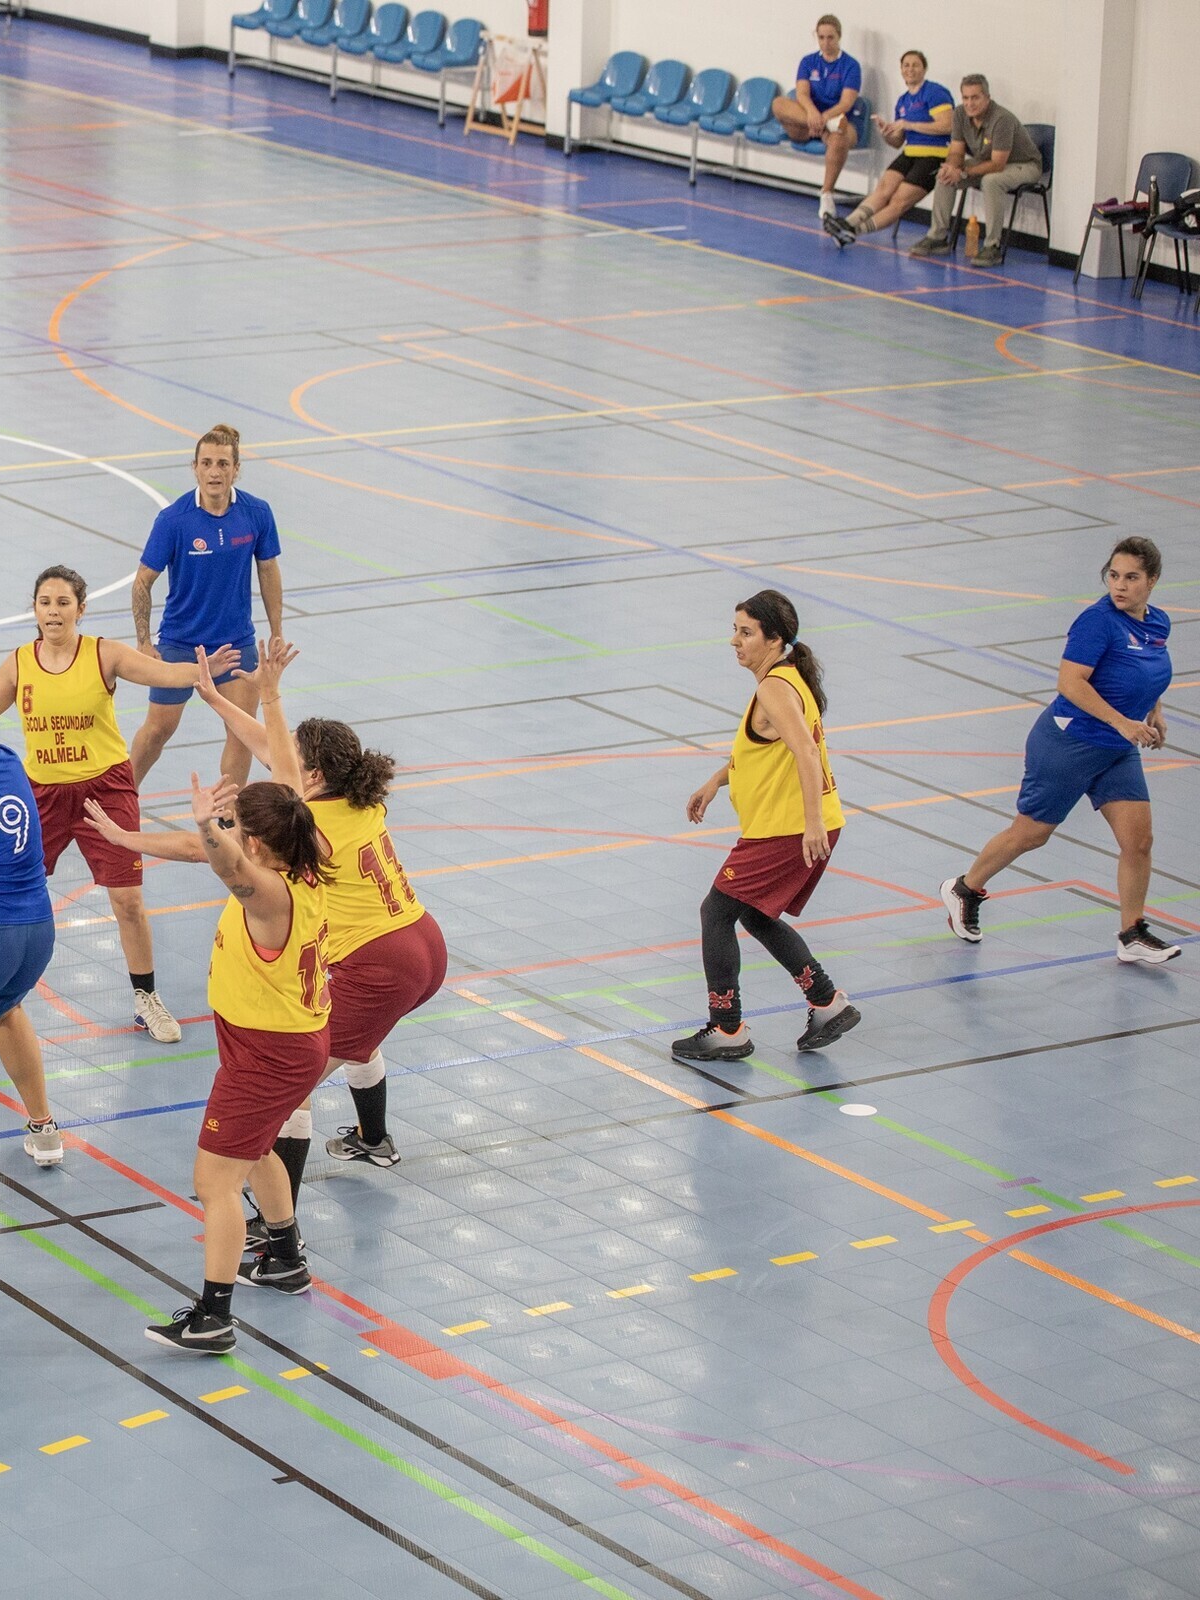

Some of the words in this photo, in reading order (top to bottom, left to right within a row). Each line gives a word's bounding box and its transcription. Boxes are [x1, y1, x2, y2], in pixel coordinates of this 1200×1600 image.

[22, 684, 34, 715] 6
[54, 732, 66, 746] DE
[36, 745, 88, 764] PALMELA
